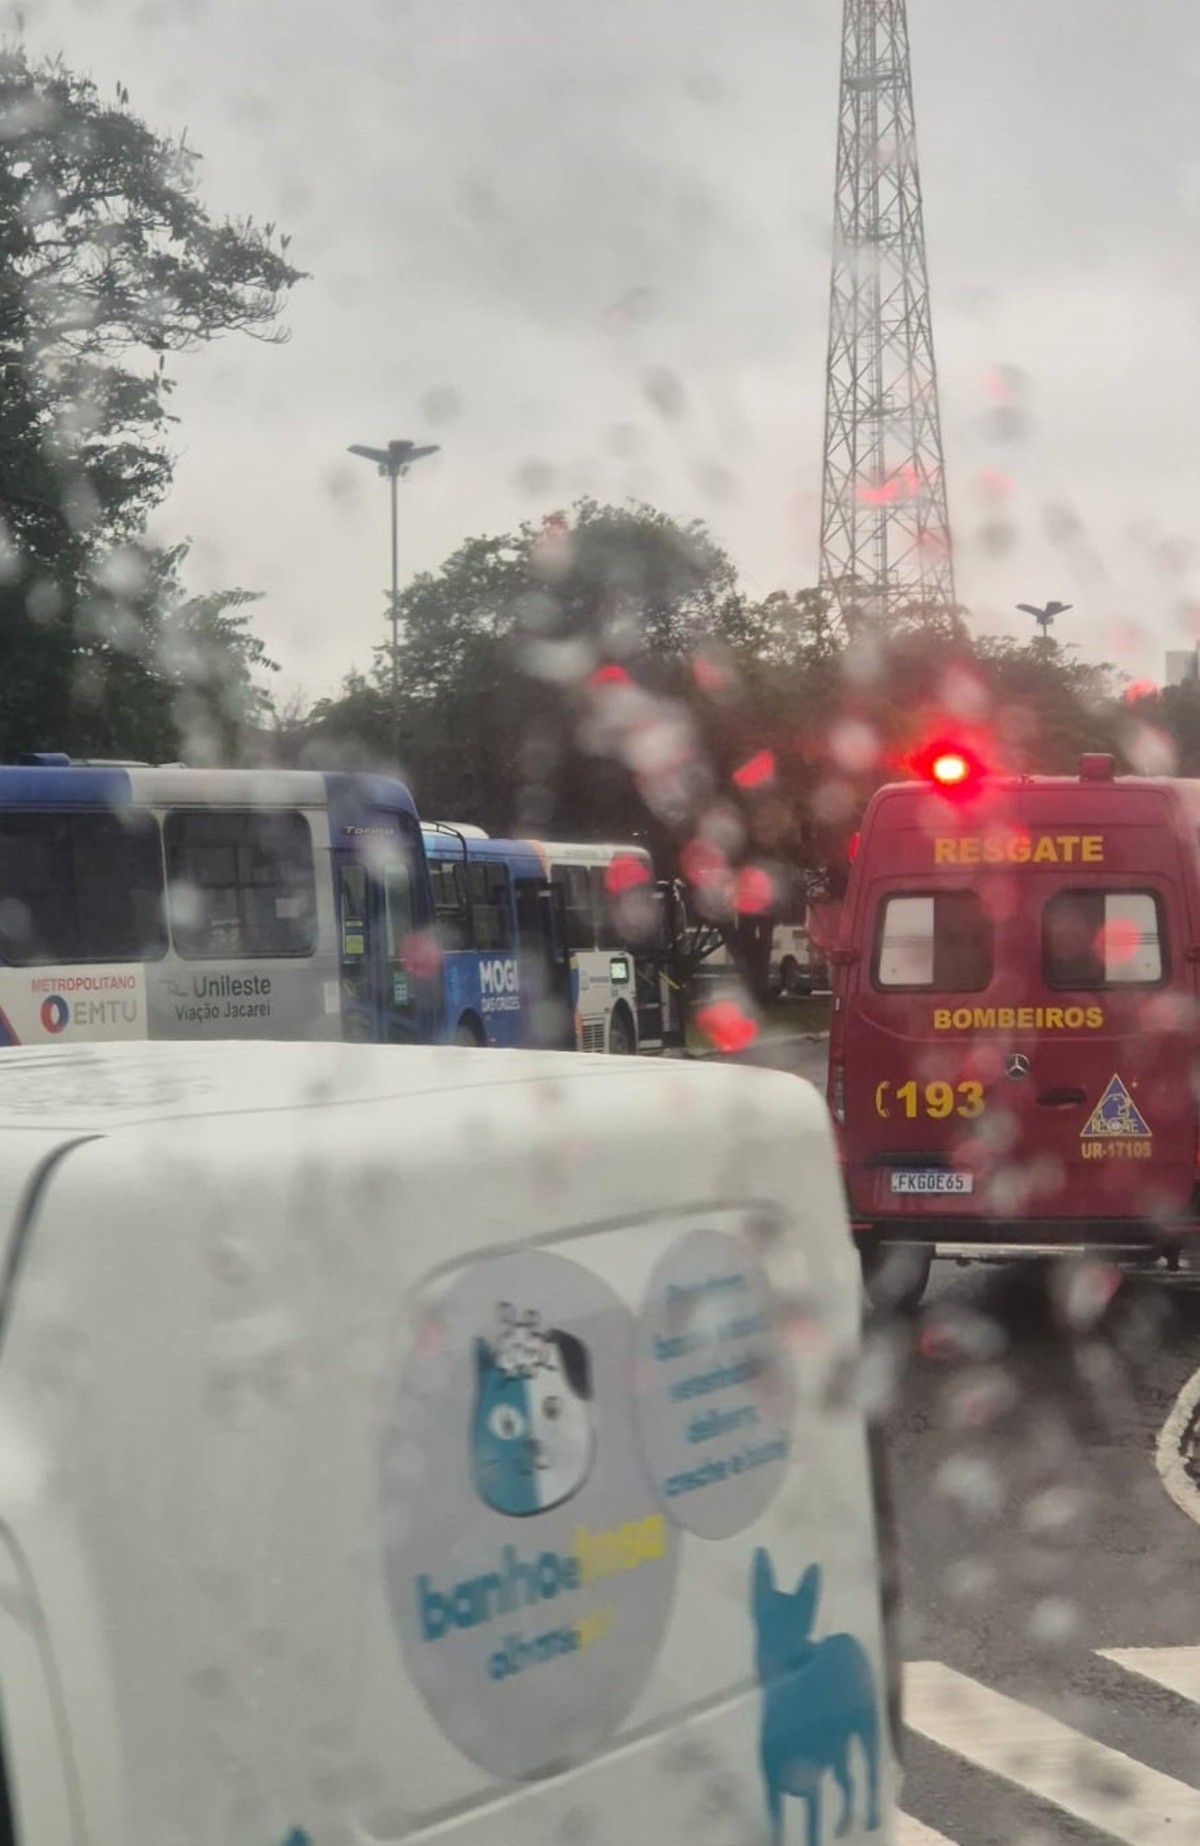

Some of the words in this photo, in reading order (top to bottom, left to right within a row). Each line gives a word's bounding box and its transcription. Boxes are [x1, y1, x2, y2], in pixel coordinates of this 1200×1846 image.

[934, 836, 1104, 864] RESGATE
[31, 976, 136, 992] METROPOLITANO
[193, 976, 271, 998] Unileste
[479, 960, 519, 993] MOGI
[74, 1000, 137, 1025] EMTU
[175, 1004, 219, 1023] Viação
[934, 1007, 1103, 1030] BOMBEIROS
[896, 1081, 985, 1118] 193
